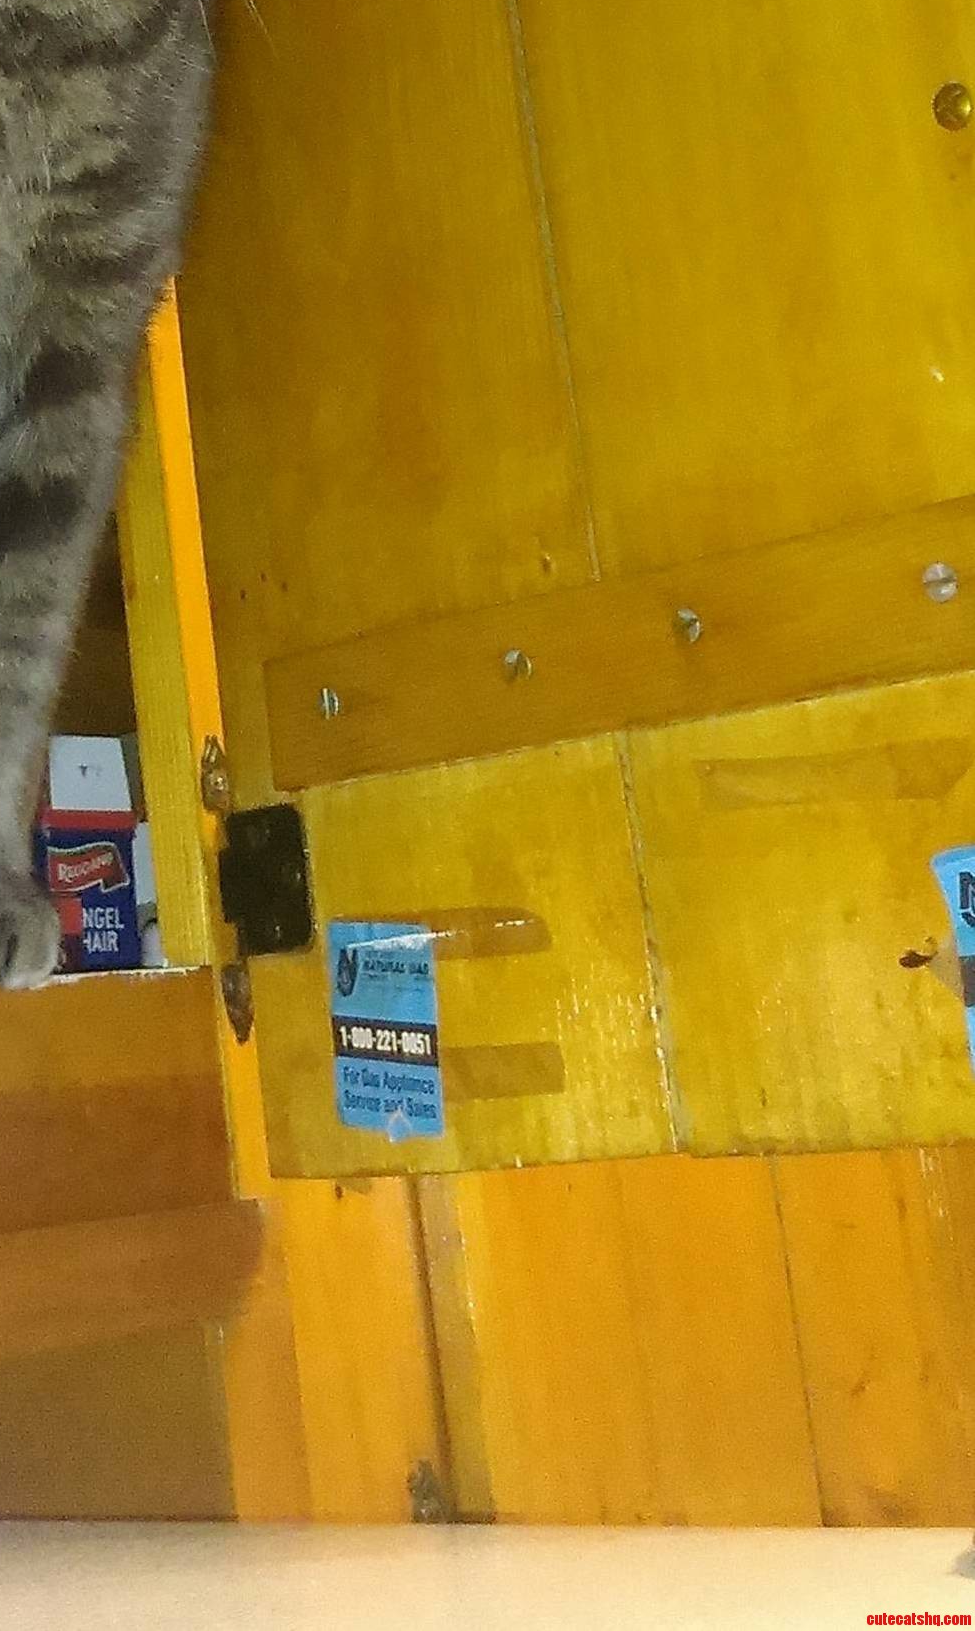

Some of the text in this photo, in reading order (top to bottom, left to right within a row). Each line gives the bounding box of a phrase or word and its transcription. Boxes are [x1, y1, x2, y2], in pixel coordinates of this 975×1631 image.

[82, 906, 125, 930] NGEL
[339, 1025, 432, 1056] 1-800-221-0051
[383, 1071, 435, 1095] Appliance
[343, 1089, 381, 1112] Service
